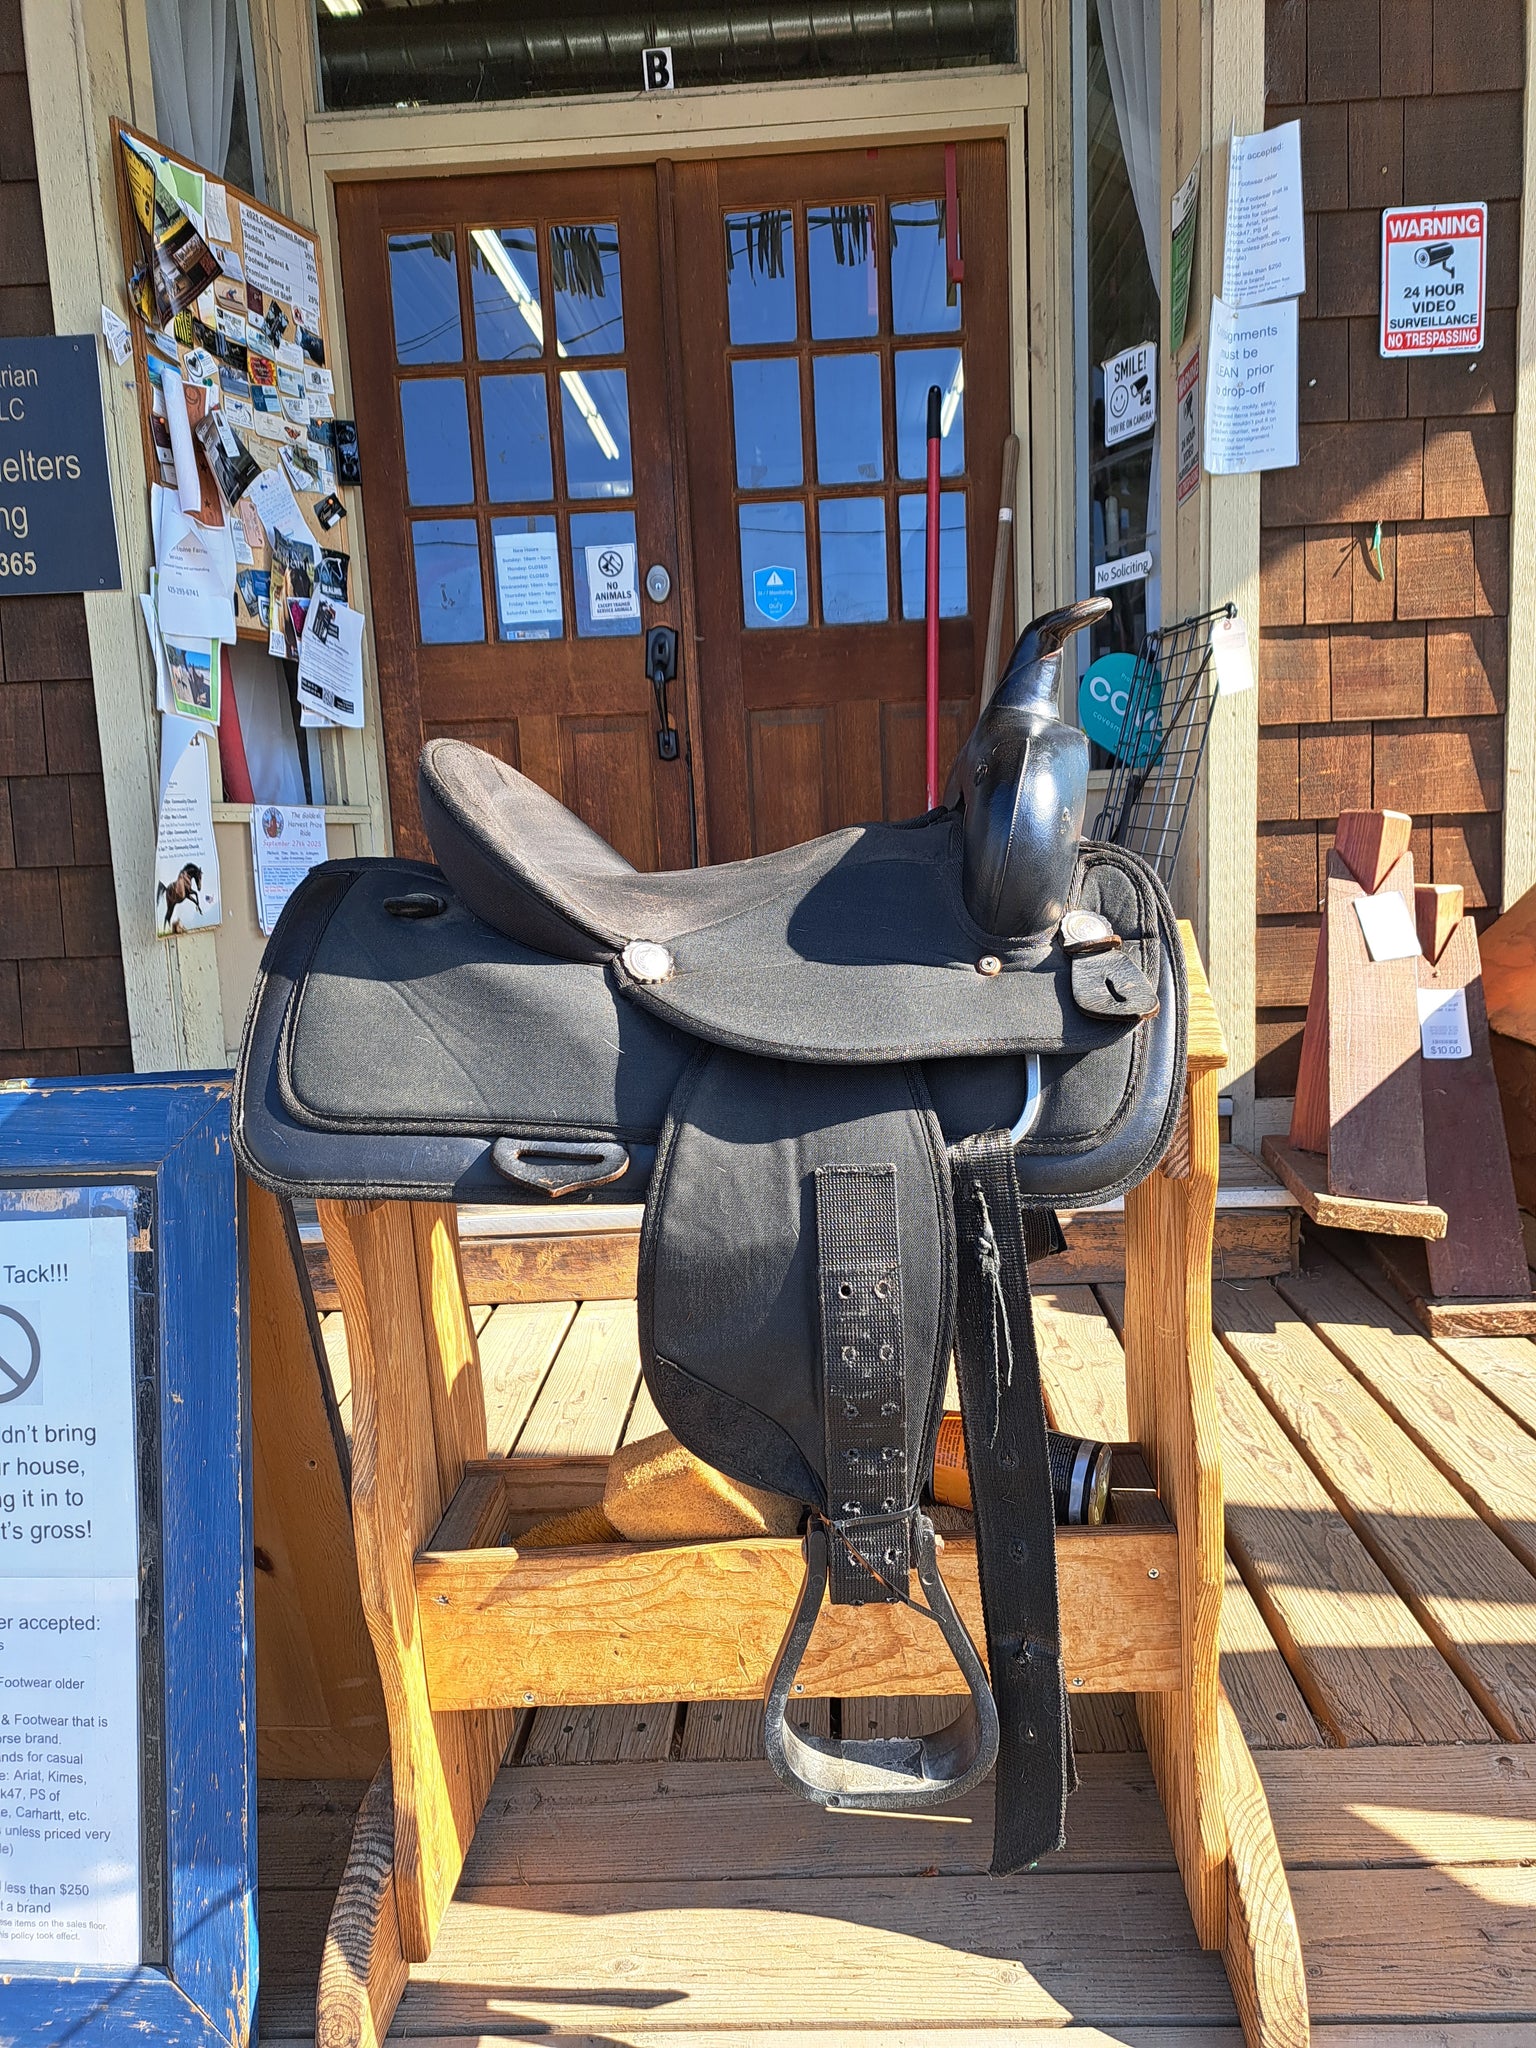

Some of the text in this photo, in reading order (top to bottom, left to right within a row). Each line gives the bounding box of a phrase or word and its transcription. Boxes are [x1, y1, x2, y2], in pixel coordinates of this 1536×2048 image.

[646, 50, 670, 89] B
[1388, 214, 1481, 239] WARNING
[1403, 283, 1465, 299] 24 HOUR
[1412, 299, 1456, 314] VIDEO
[1389, 313, 1478, 329] SURVEILLANCE
[1387, 328, 1478, 348] NO TRESPASSING
[1243, 347, 1259, 360] be
[1114, 350, 1147, 383] SMILE!
[1247, 363, 1275, 379] prior
[0, 364, 39, 388] rian
[1221, 381, 1267, 399] drop-off
[0, 450, 82, 482] elters
[1097, 559, 1150, 584] No Soliciting
[606, 581, 618, 590] NO
[595, 590, 632, 601] ANIMALS
[5, 1263, 69, 1284] Tack!!!
[45, 1423, 97, 1446] bring
[17, 1456, 86, 1477] house,
[22, 1489, 34, 1508] it
[41, 1488, 58, 1507] in
[65, 1488, 84, 1506] to
[30, 1519, 92, 1544] gross!
[19, 1615, 101, 1634] accepted:
[55, 1677, 86, 1689] older
[1, 1713, 109, 1728] & Footwear that is
[25, 1732, 62, 1745] brand.
[27, 1750, 44, 1762] for
[46, 1753, 83, 1765] casual
[13, 1769, 45, 1783] Ariat,
[48, 1770, 87, 1786] Kimes,
[29, 1788, 46, 1801] PS
[49, 1790, 61, 1802] of
[15, 1806, 65, 1823] Carhartt,
[68, 1810, 90, 1821] etc.
[5, 1825, 112, 1843] unless priced very
[4, 1881, 90, 1896] less than $250
[6, 1903, 13, 1912] a
[17, 1902, 51, 1914] brand
[14, 1919, 108, 1931] items on the sales floor.
[10, 1931, 81, 1941] policy took effect.
